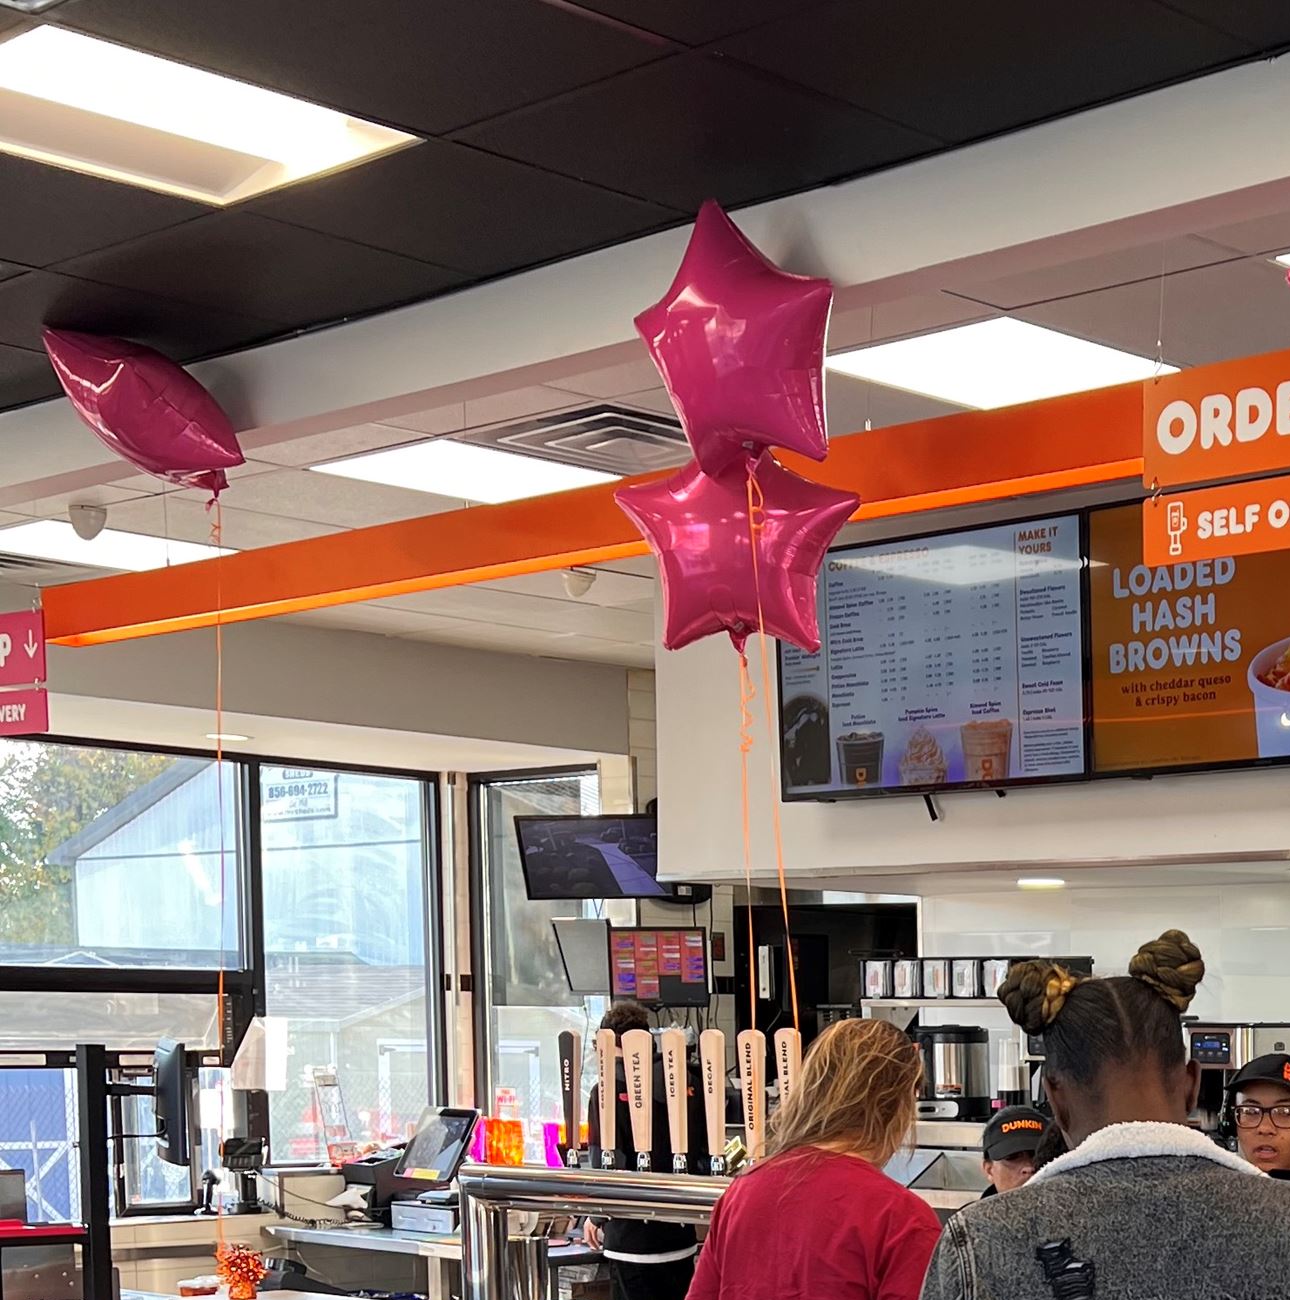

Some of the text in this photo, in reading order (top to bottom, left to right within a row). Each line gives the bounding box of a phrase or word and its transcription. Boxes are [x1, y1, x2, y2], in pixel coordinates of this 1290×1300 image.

[1018, 526, 1058, 542] MAKE IT
[1197, 504, 1261, 540] SELF
[1019, 541, 1052, 555] YOURS
[1113, 556, 1236, 599] LOADED
[1132, 592, 1216, 634] HASH
[1109, 628, 1241, 674] BROWNS
[1121, 675, 1232, 694] with cheddar queso
[1135, 690, 1217, 707] & crispy bacon
[268, 783, 328, 798] 856-694-2722
[634, 1070, 643, 1109] GREEN
